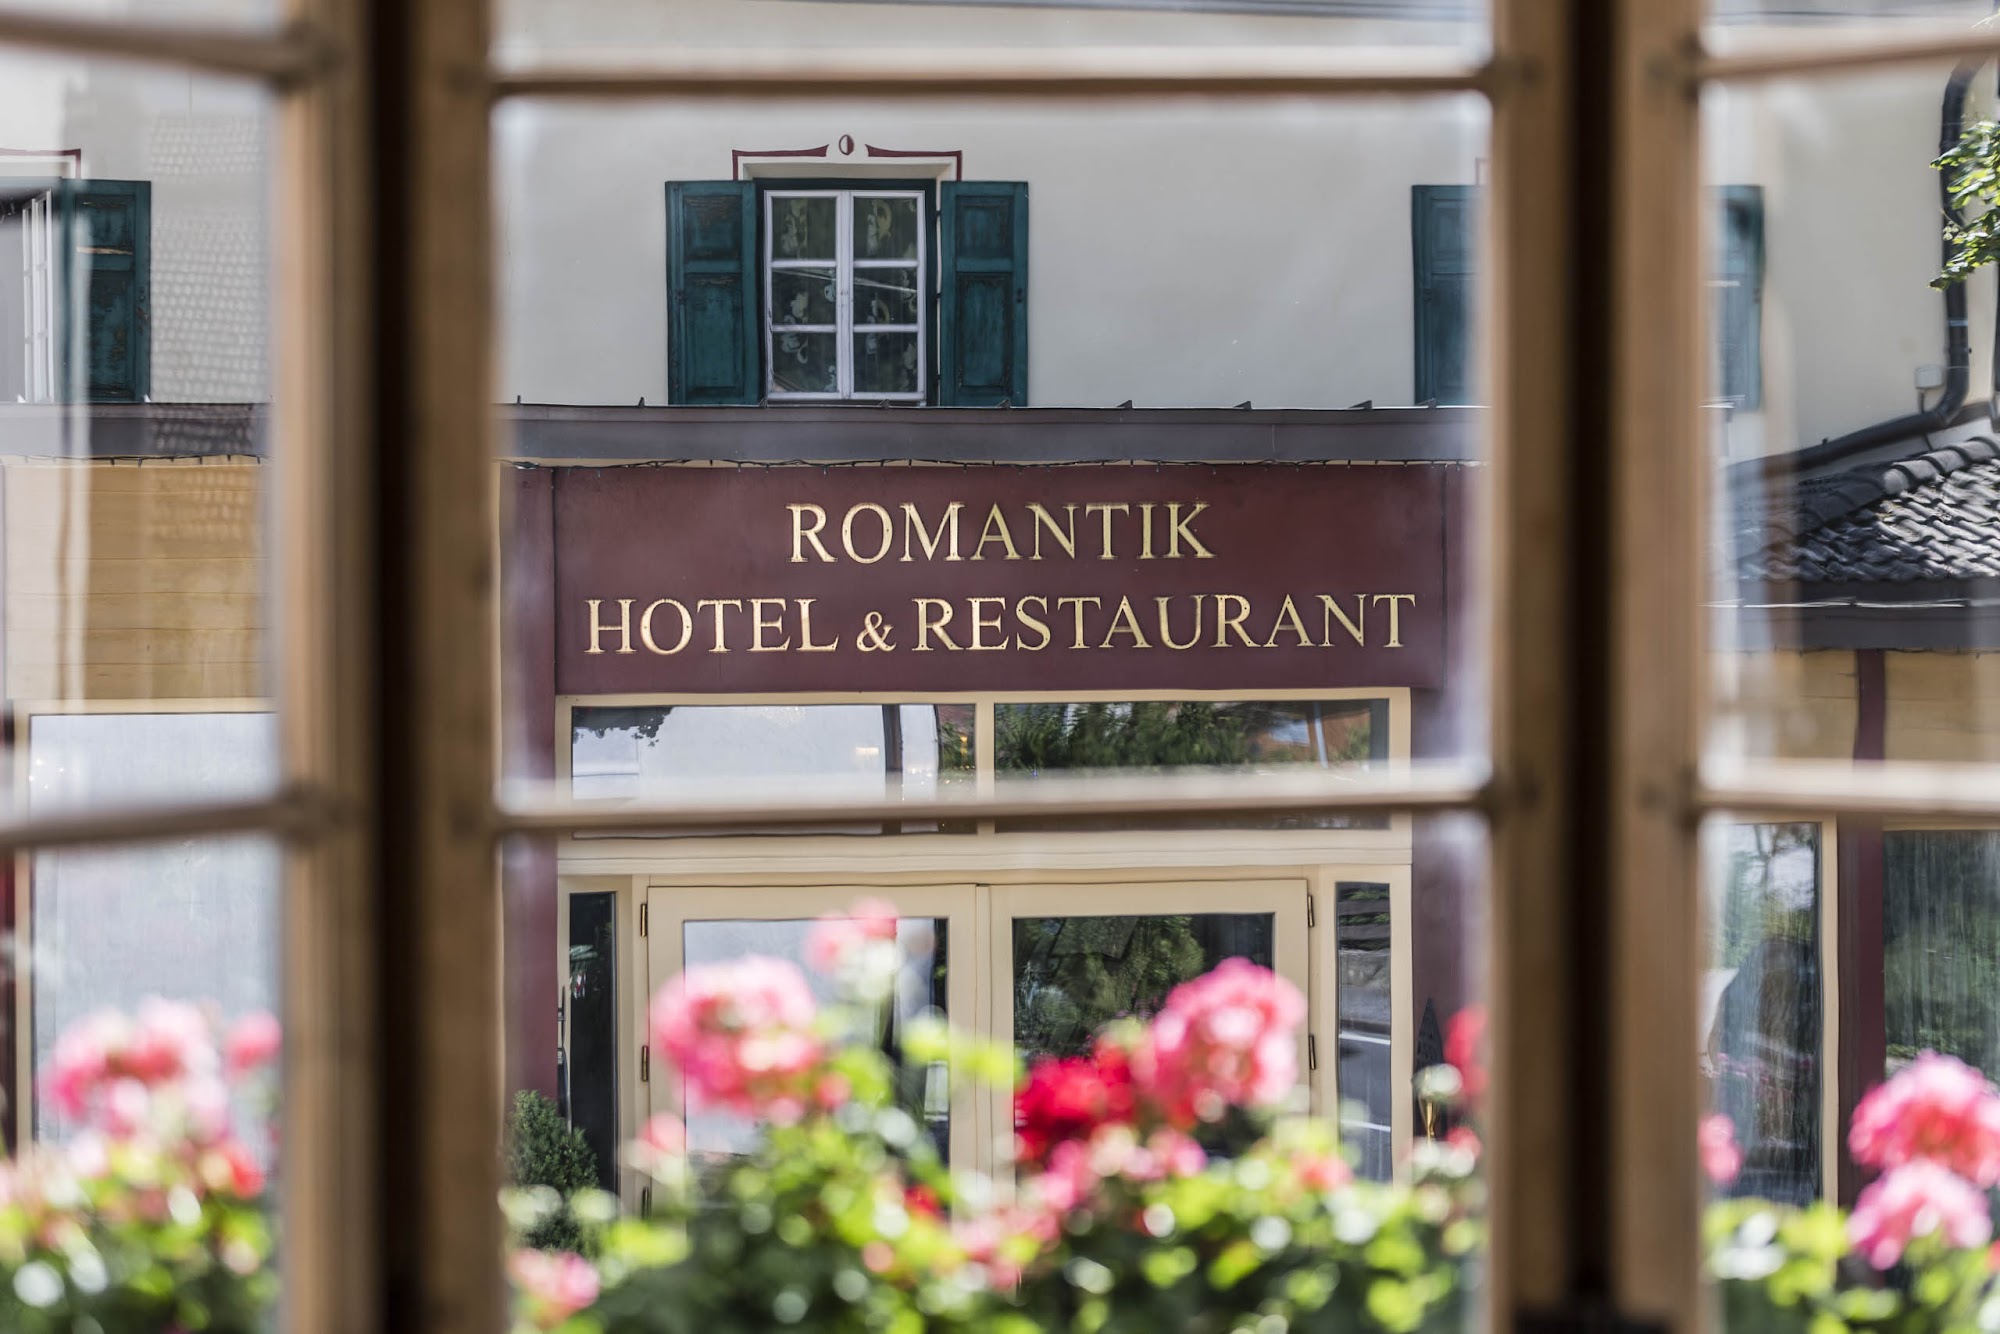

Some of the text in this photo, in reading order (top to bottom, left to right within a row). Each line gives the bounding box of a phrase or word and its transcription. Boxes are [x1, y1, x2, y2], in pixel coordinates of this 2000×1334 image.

[786, 502, 1215, 564] ROMANTIK
[584, 594, 1417, 656] HOTEL & RESTAURANT
